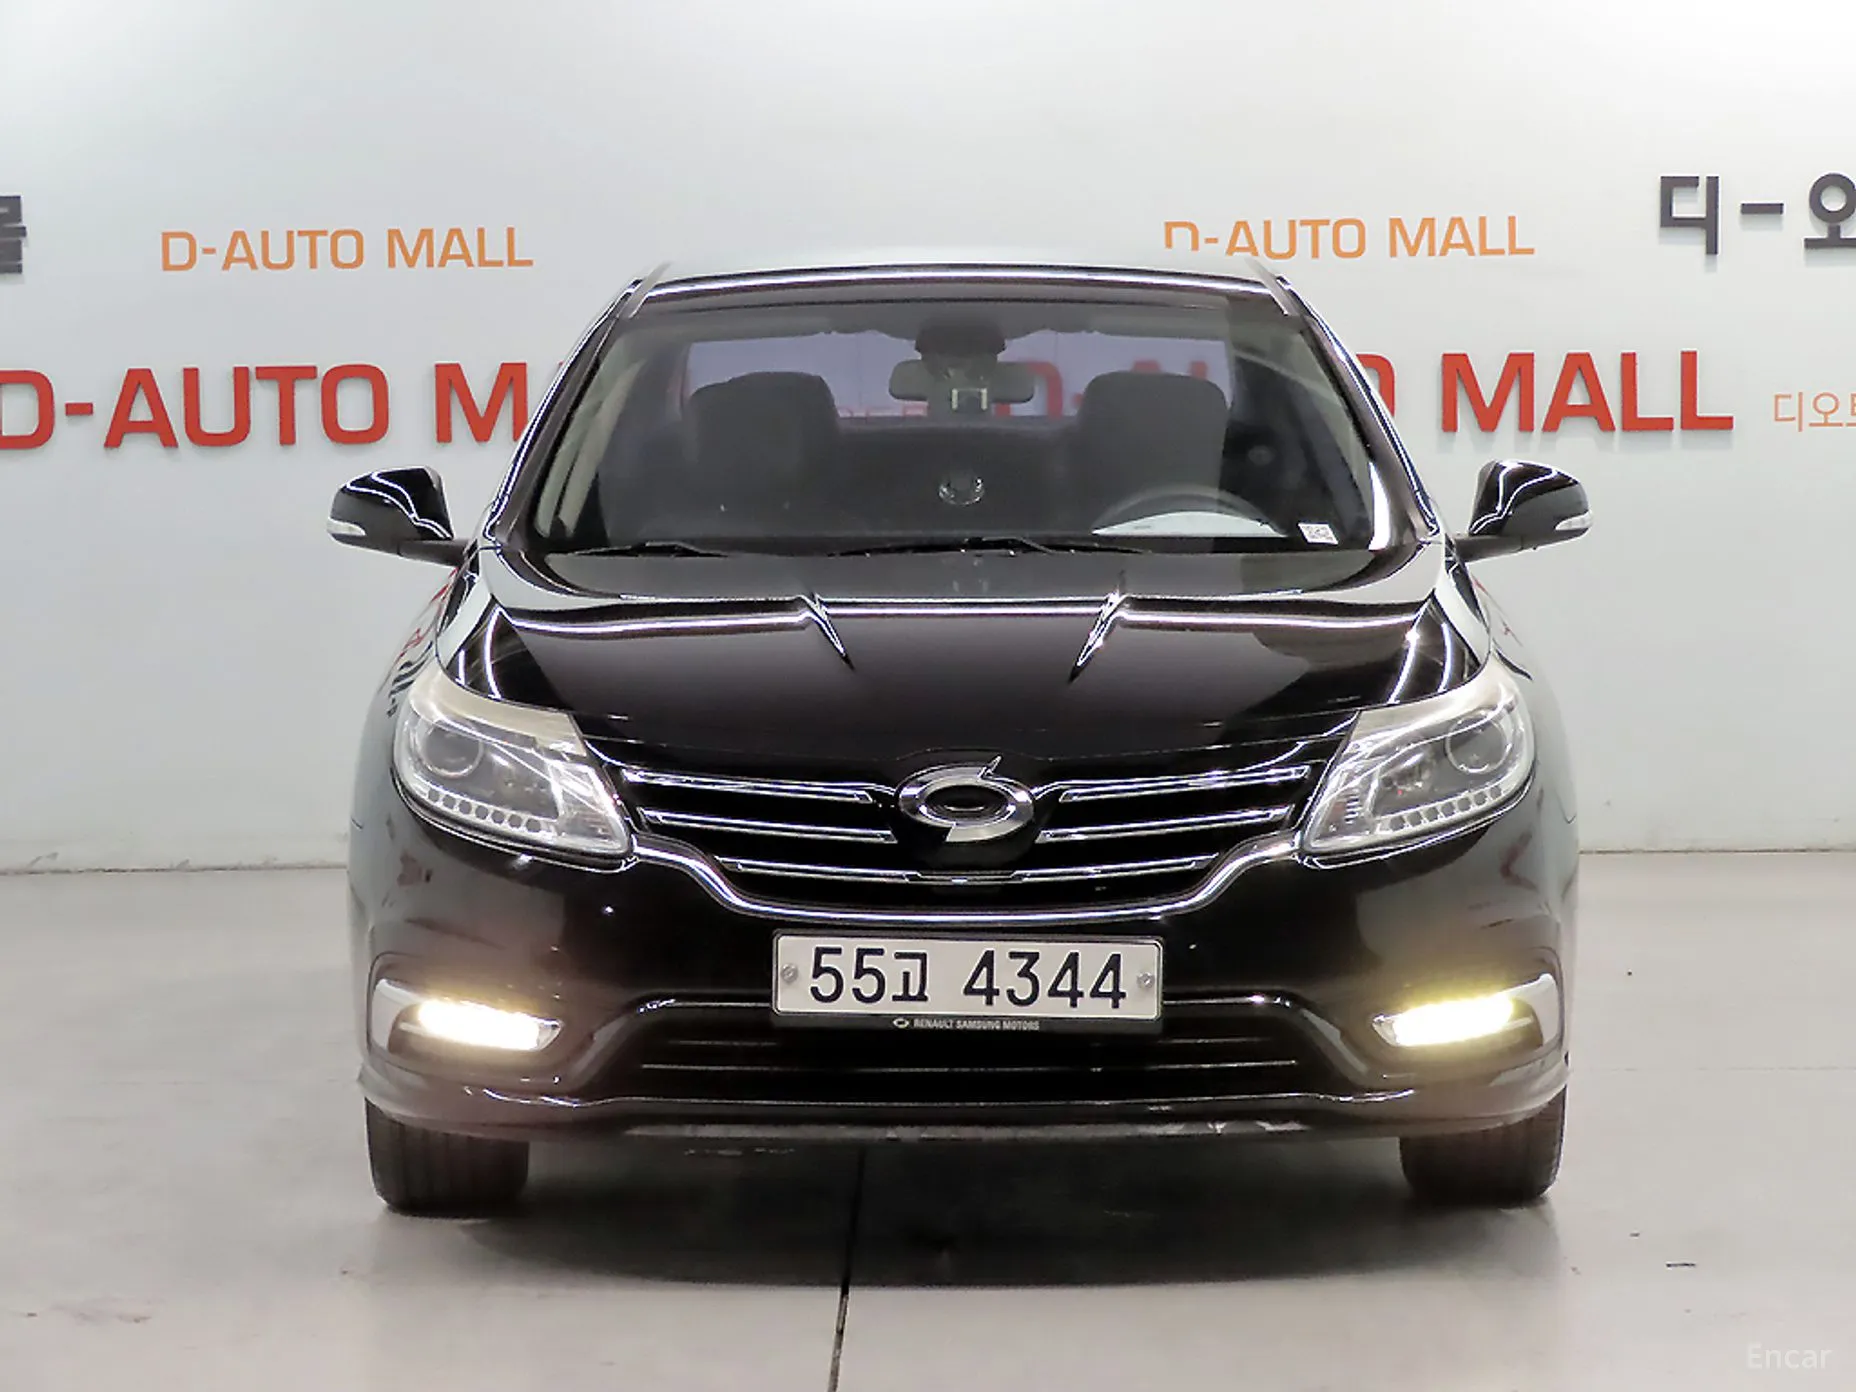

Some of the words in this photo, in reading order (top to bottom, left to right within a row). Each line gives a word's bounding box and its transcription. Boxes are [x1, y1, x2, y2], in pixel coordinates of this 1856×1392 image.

[161, 228, 365, 272] D-AUTO
[386, 226, 534, 269] MALL
[1388, 215, 1536, 257] MALL
[0, 364, 390, 450] D-AUTO
[1441, 350, 1735, 433] MALL
[810, 946, 929, 1004] 55고
[963, 950, 1127, 1009] 4344
[913, 1018, 954, 1029] RENAULT
[956, 1019, 1001, 1030] SAMSUNG
[1002, 1020, 1040, 1031] MOTORS
